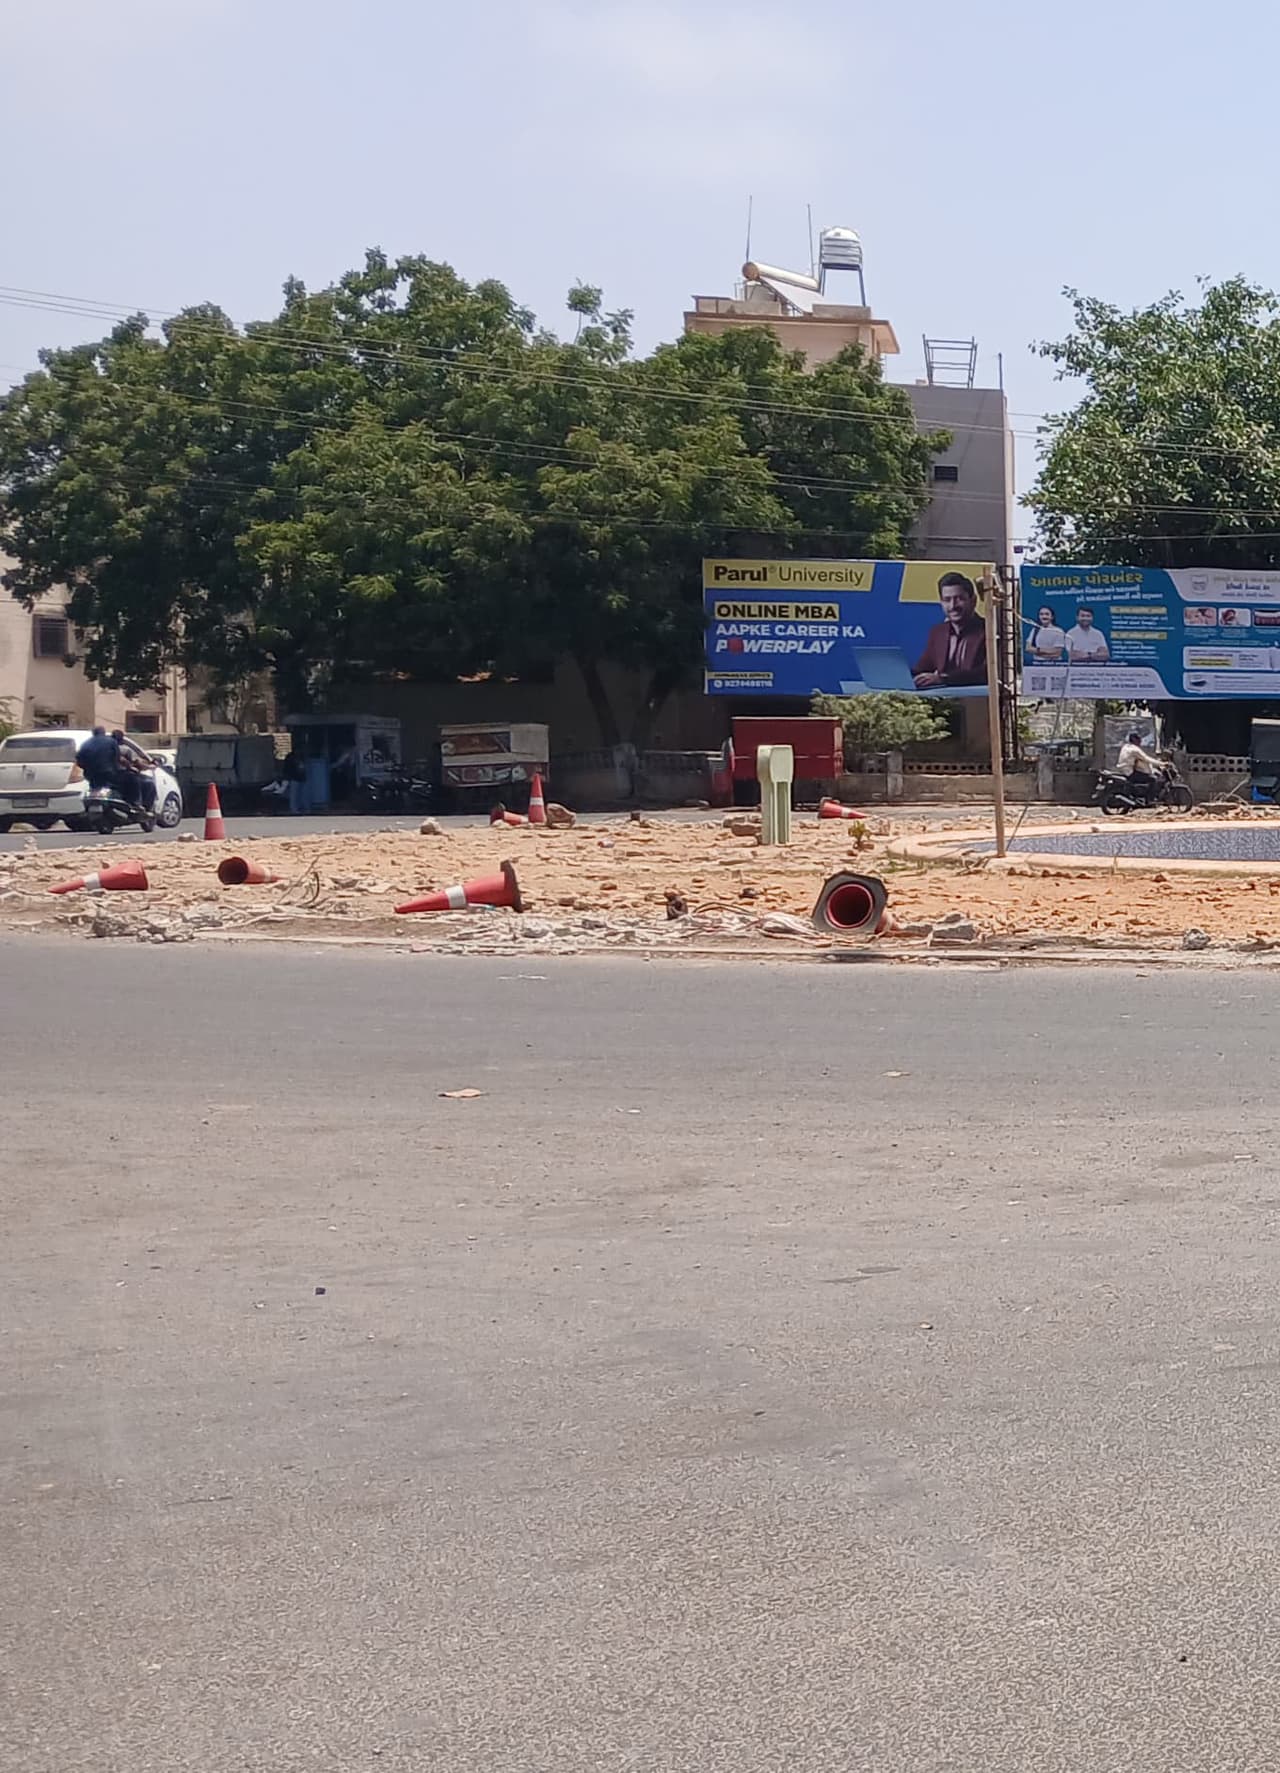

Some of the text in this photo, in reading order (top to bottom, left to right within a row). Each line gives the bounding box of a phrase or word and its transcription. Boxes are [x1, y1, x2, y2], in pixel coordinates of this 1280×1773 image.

[714, 566, 864, 586] Parul University
[716, 604, 837, 619] ONLINE MBA
[716, 623, 865, 638] AAPKE CAREER KA
